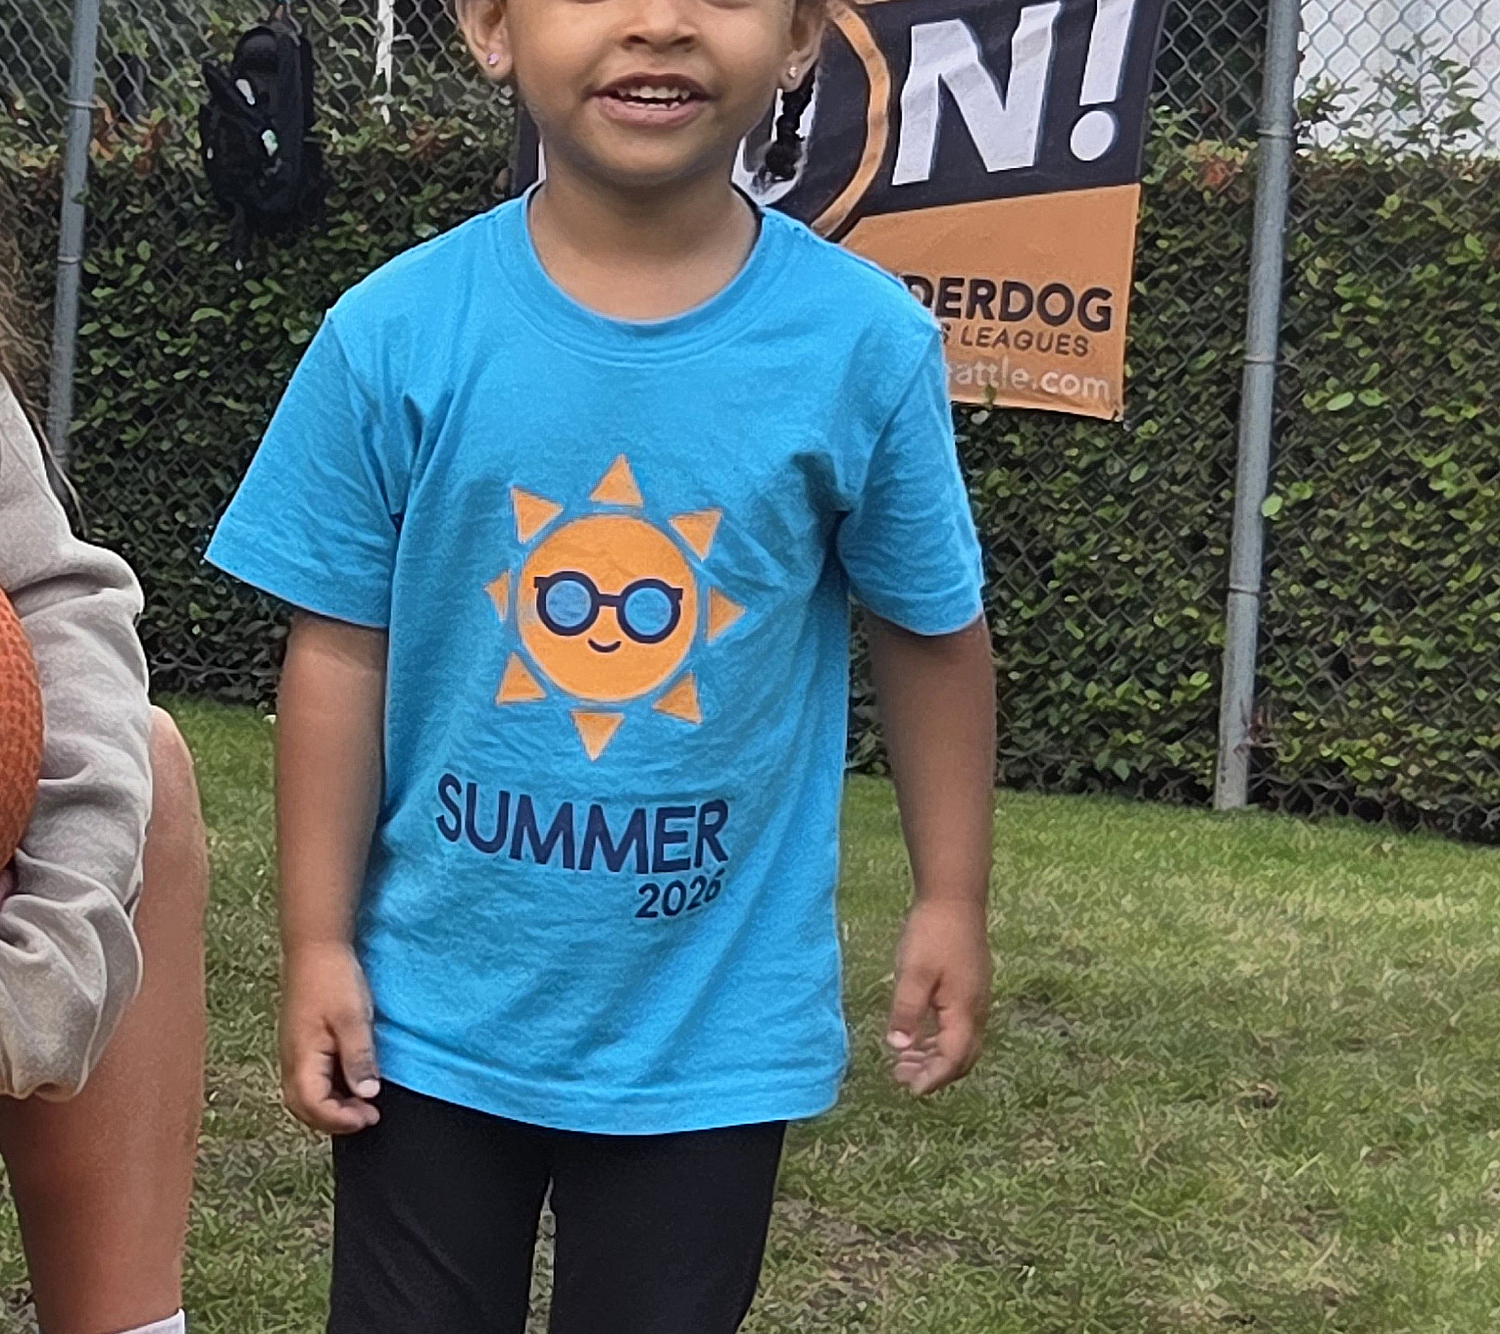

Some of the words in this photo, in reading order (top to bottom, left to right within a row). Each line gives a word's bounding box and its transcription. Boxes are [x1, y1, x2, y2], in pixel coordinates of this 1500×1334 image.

[901, 274, 1113, 333] DERDOG
[960, 324, 1090, 358] LEAGUES
[950, 355, 1111, 401] attle.com
[436, 772, 729, 875] SUMMER
[634, 867, 726, 918] 2026
